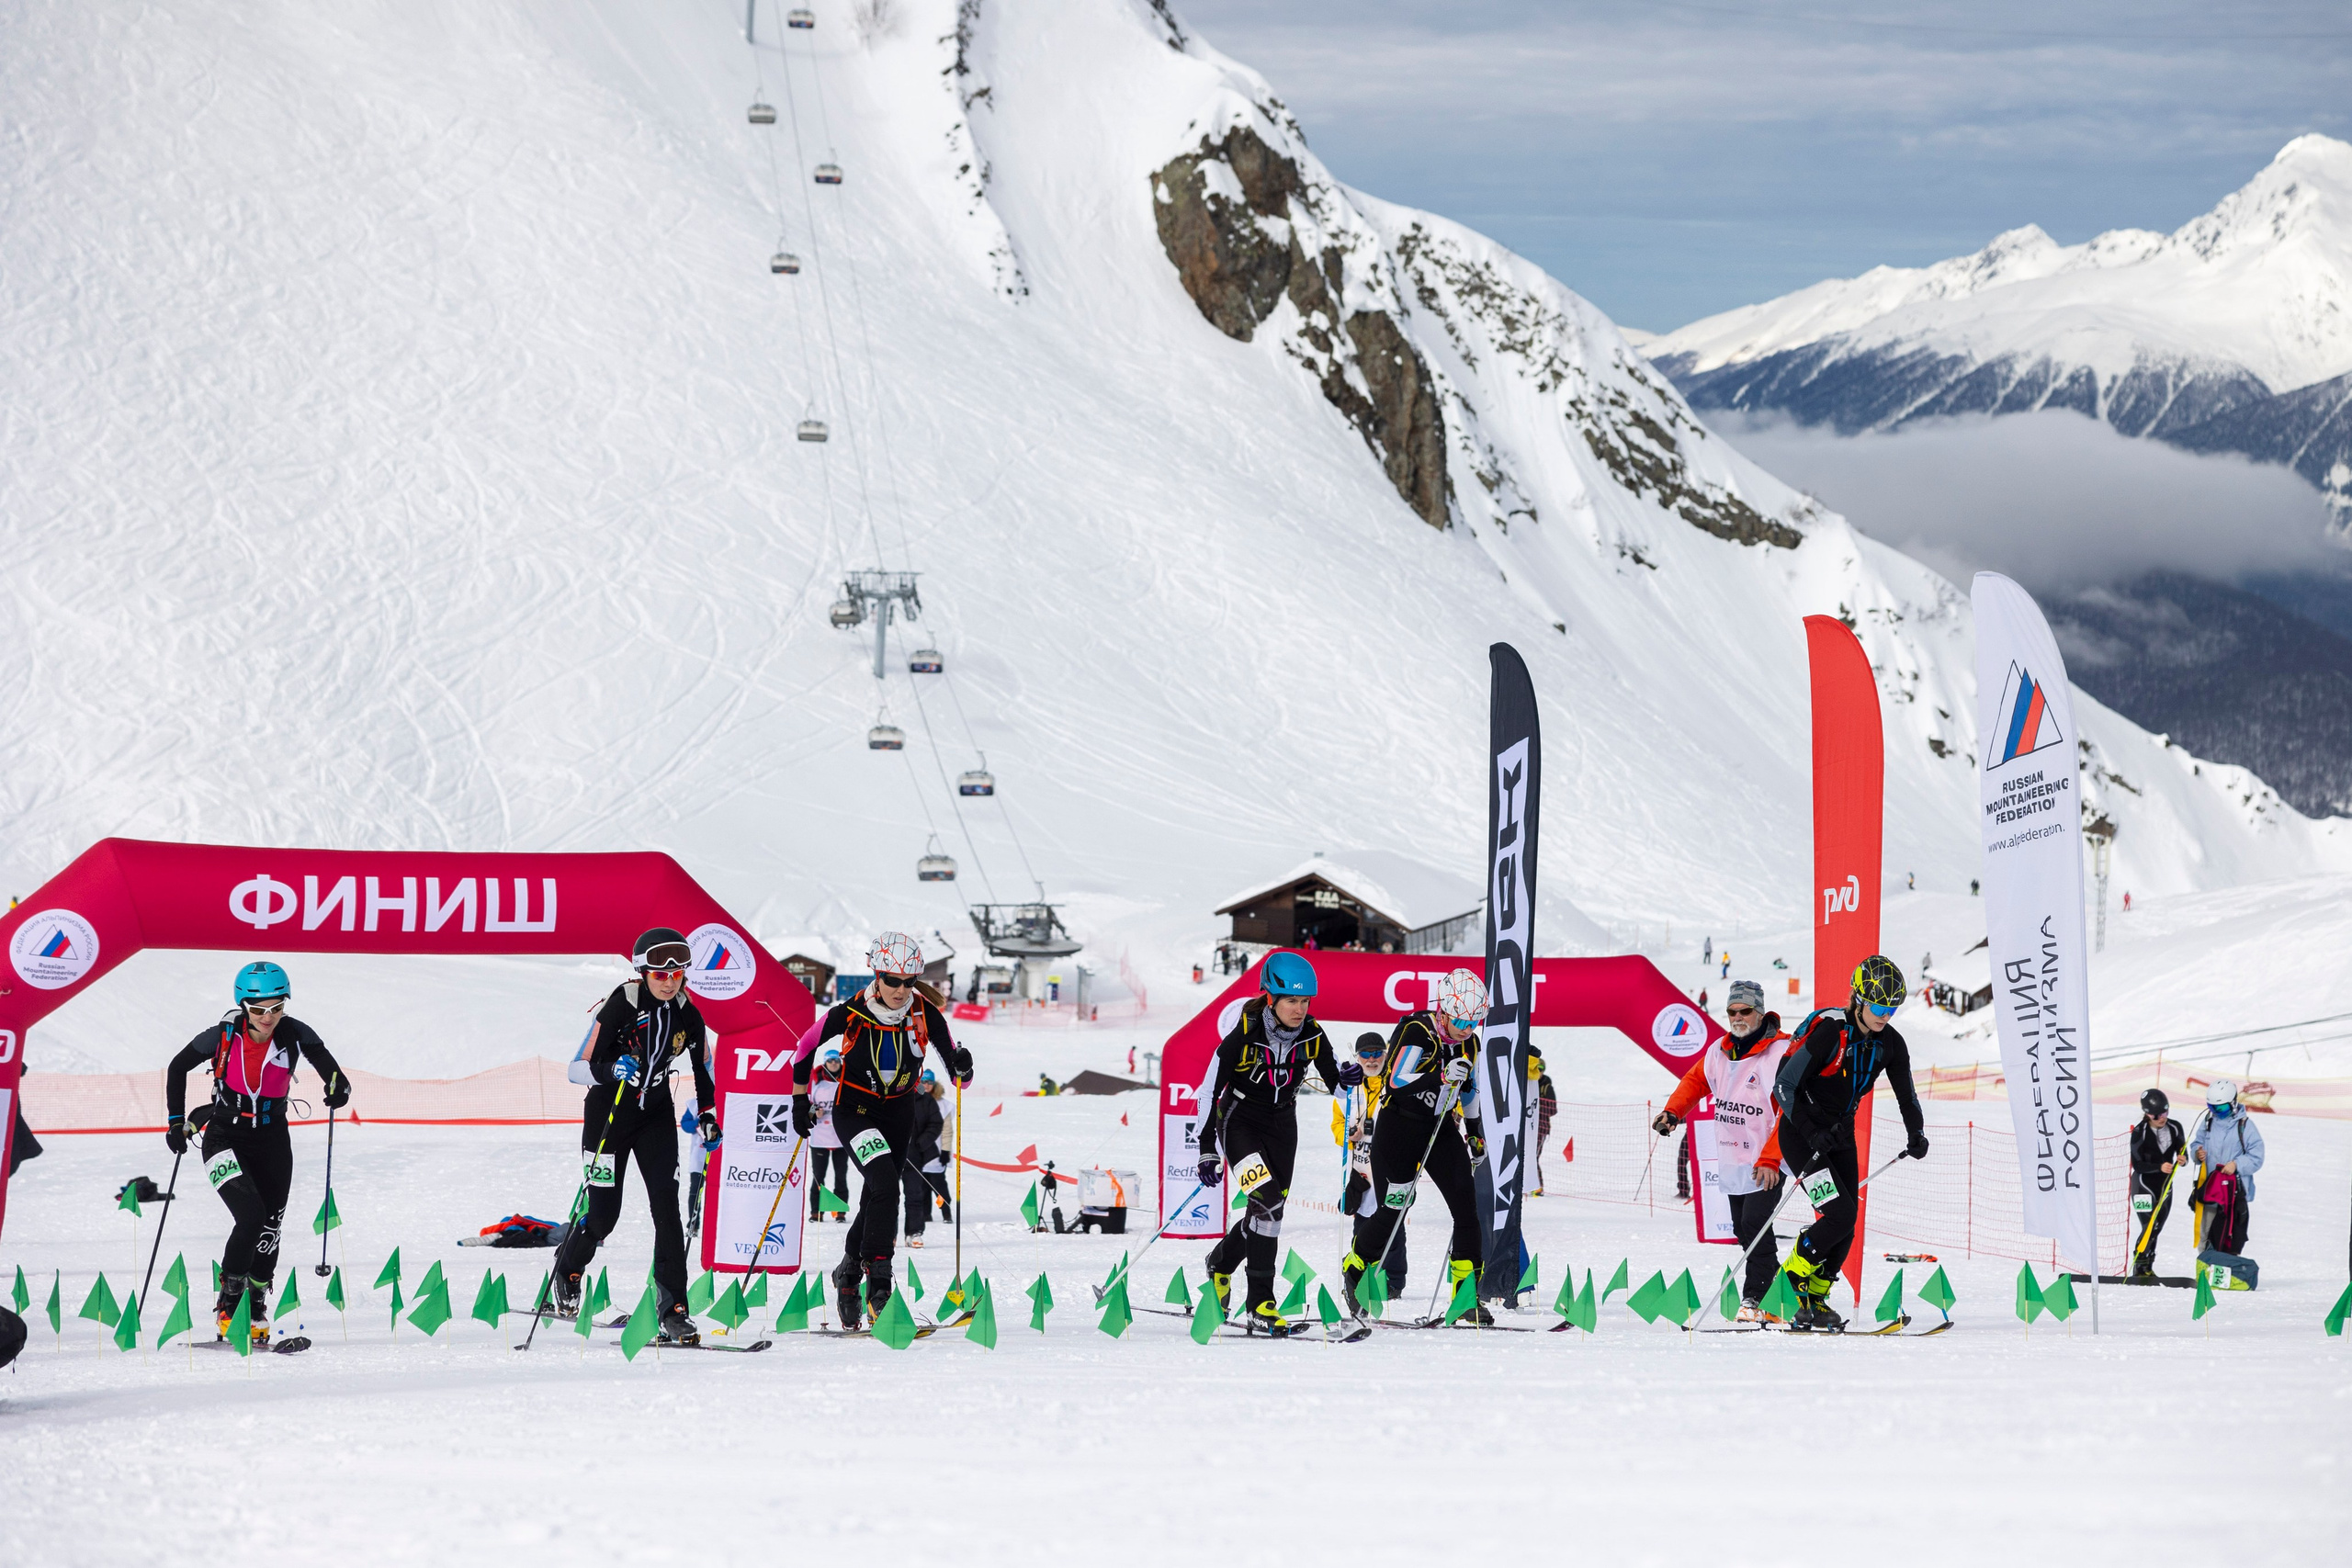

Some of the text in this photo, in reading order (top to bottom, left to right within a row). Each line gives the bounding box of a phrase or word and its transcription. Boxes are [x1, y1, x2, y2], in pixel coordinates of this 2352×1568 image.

[2003, 771, 2043, 794] RUSSIAN
[1986, 778, 2069, 815] MOUNTAINEERING
[229, 874, 557, 932] ФИНИШ
[1315, 890, 1339, 901] ЕДА
[17, 915, 94, 961] ФЕДЕРАЦИЯ АЛЬПИНИЗМА РОССИИ
[701, 929, 739, 944] АЛЬПИНИЗМА
[739, 943, 751, 969] РОССИИ
[23, 966, 78, 976] Mountaineering
[858, 1137, 885, 1158] 218
[209, 1159, 238, 1184] 204
[1240, 1163, 1268, 1188] 402
[1387, 1193, 1408, 1204] 23
[1811, 1181, 1835, 1201] 212
[2136, 1201, 2151, 1209] 214
[1174, 1219, 1205, 1227] VENTO
[734, 1243, 779, 1255] VENTO
[2214, 1268, 2224, 1285] 214
